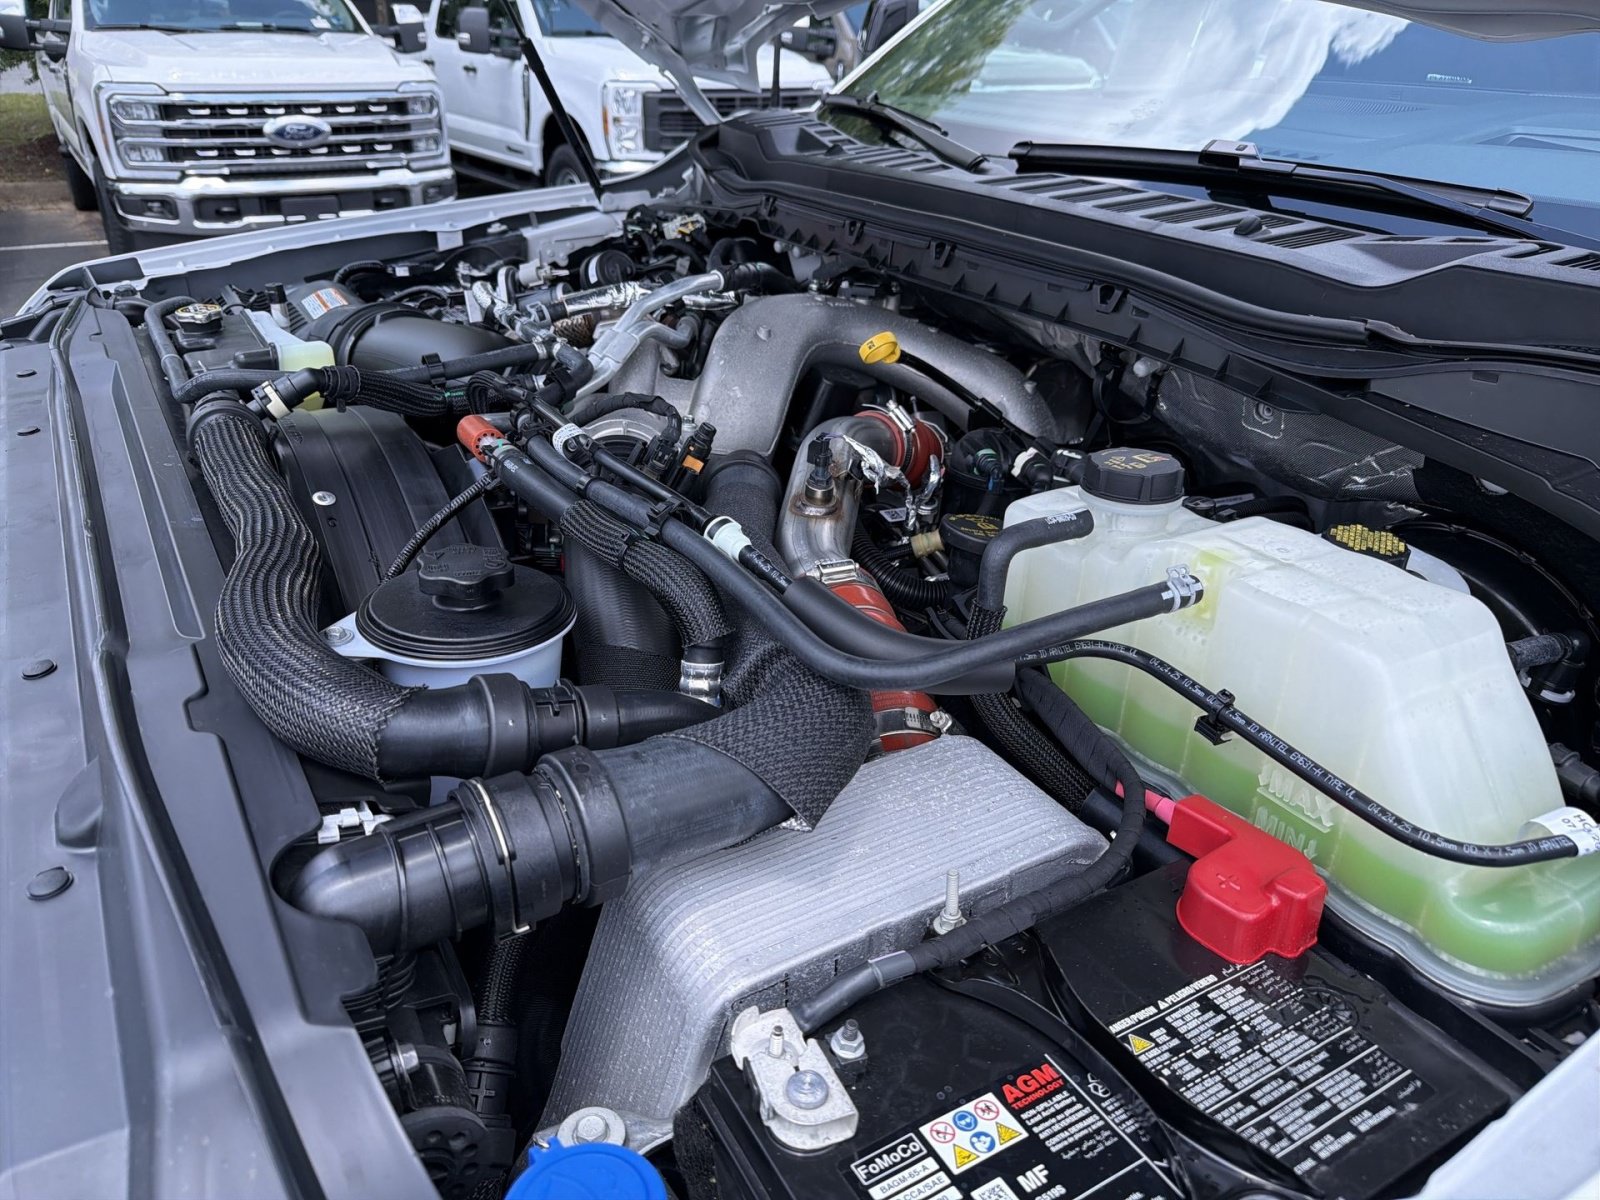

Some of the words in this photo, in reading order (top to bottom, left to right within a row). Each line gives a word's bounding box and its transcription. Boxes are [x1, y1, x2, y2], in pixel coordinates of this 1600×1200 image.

[284, 124, 314, 139] Ford
[1049, 643, 1073, 656] ARNITEL
[1107, 642, 1126, 653] TYPE
[1149, 657, 1183, 681] 04.24.25
[1182, 678, 1206, 698] 10.5mm
[1225, 707, 1246, 726] 7.5mm
[1259, 731, 1290, 755] ARNITEL
[1324, 773, 1346, 792] TYPE
[1367, 802, 1414, 833] 04.24.25
[1417, 830, 1458, 851] 10.5mm
[1463, 843, 1478, 854] OD
[1498, 846, 1525, 857] 7.5mm
[1538, 835, 1574, 853] ARNITEL
[1269, 768, 1338, 827] MAX
[1255, 806, 1306, 853] MIN
[1162, 973, 1219, 1004] PELIGRO/VENENO
[1106, 1004, 1159, 1033] ANGER/POISON
[1002, 1063, 1061, 1104] AGM
[1011, 1078, 1065, 1110] TECHNOLOGY
[1019, 1089, 1070, 1120] NON-SPILLABLE
[1024, 1113, 1043, 1126] Lead
[1039, 1105, 1057, 1117] Acid
[1052, 1094, 1078, 1111] Battery
[1036, 1127, 1054, 1139] ANTI
[1043, 1129, 1071, 1147] CONTRA
[1066, 1112, 1101, 1134] DERRAMES
[856, 1140, 922, 1180] FoMoCo
[879, 1164, 930, 1194] BAGM-65-A
[1016, 1163, 1050, 1193] MF
